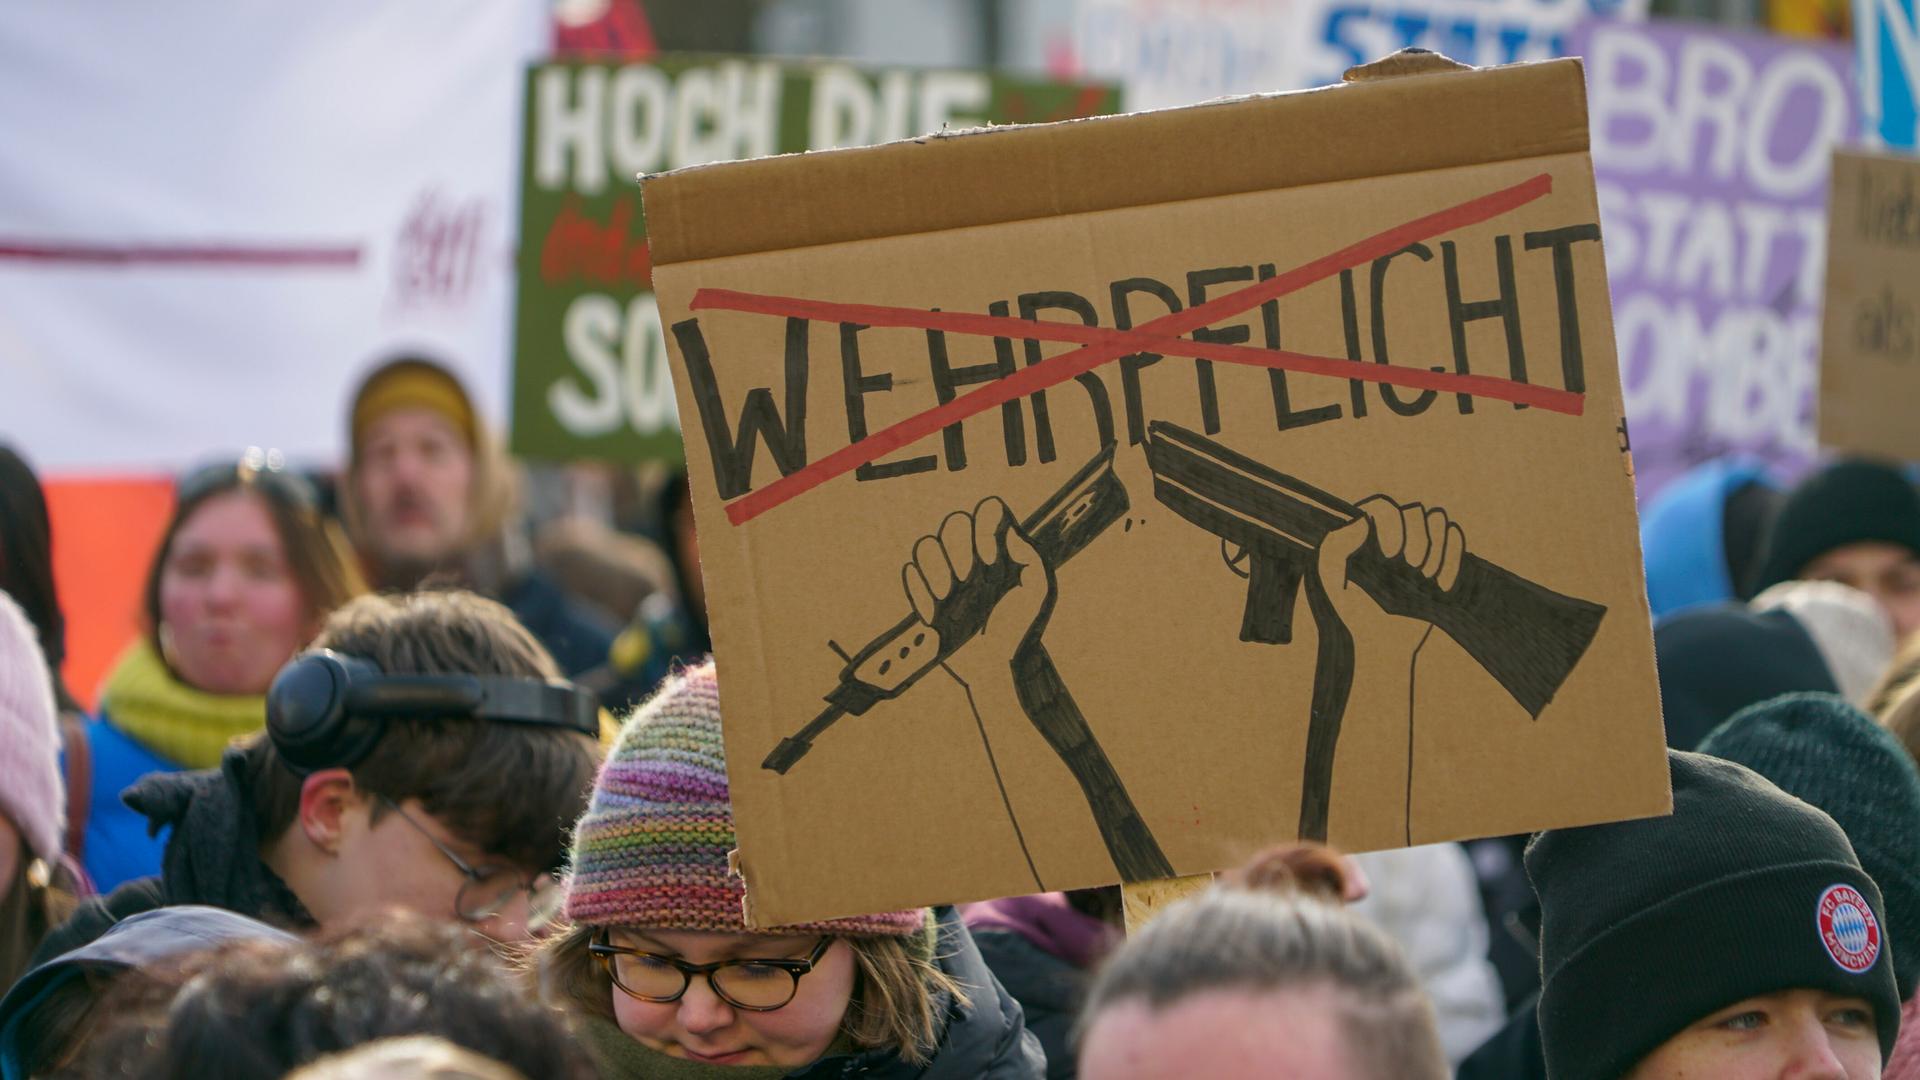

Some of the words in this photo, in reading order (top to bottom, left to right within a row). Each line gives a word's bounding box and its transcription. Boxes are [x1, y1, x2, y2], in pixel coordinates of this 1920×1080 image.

[535, 63, 782, 194] HOCH
[548, 293, 681, 434] SO
[671, 223, 1601, 499] WEHRPFLICHT
[1822, 898, 1835, 918] FC
[1833, 889, 1875, 927] BAYERN
[1825, 931, 1877, 967] MÜNCHEN
